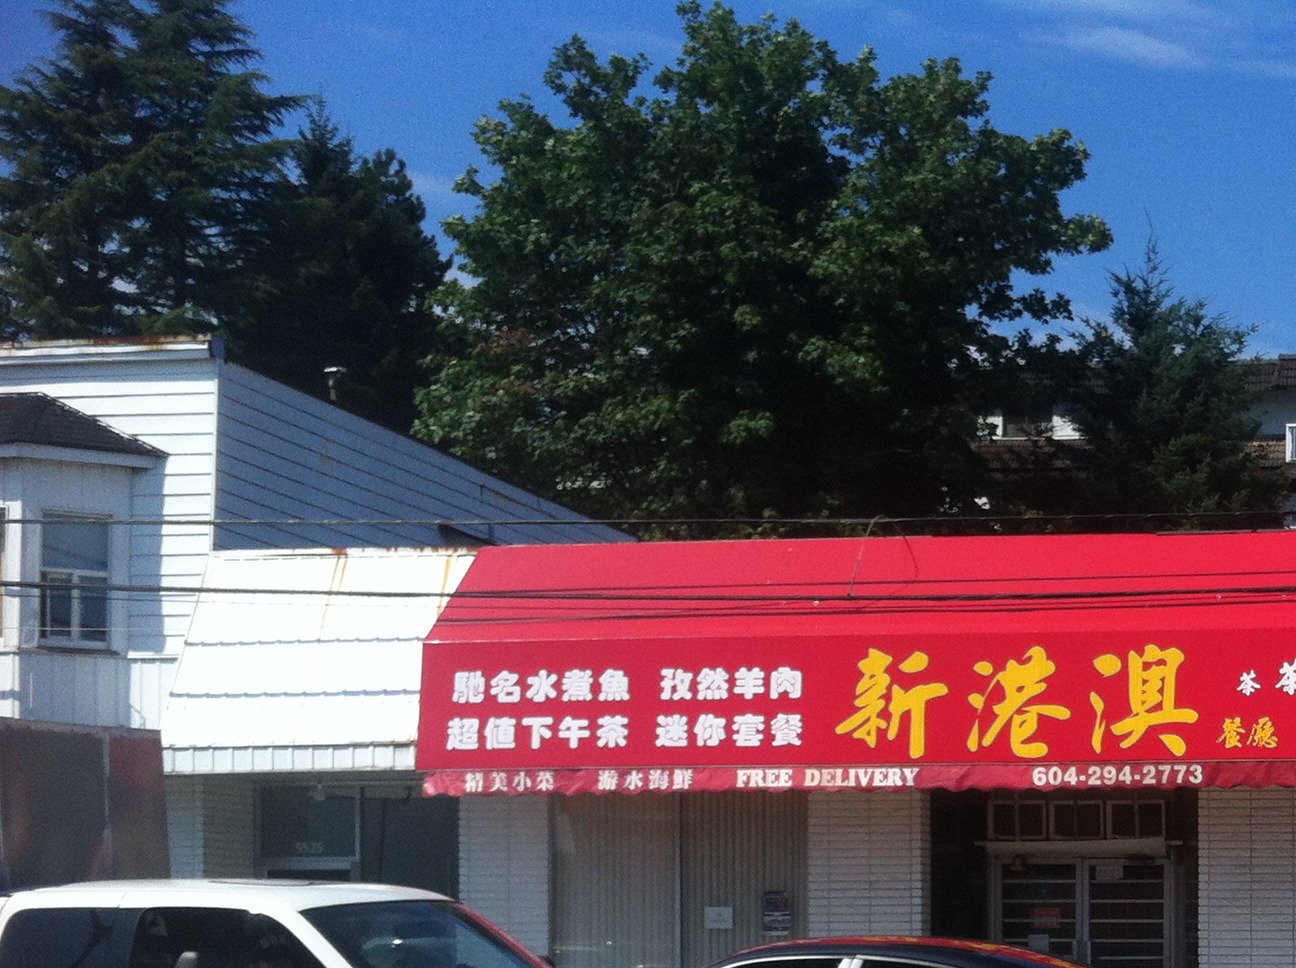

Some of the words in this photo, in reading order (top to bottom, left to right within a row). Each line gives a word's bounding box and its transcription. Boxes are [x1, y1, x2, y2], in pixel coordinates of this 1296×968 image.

[451, 668, 631, 704] 馳名水煮魚
[659, 666, 803, 701] 孜然羊肉
[834, 644, 1199, 759] 新港澳
[445, 714, 630, 751] 超值下午茶
[654, 712, 803, 748] 迷你套餐
[735, 768, 794, 788] FREE
[803, 767, 920, 788] DELIVERY
[1032, 764, 1204, 787] 604-294-2773
